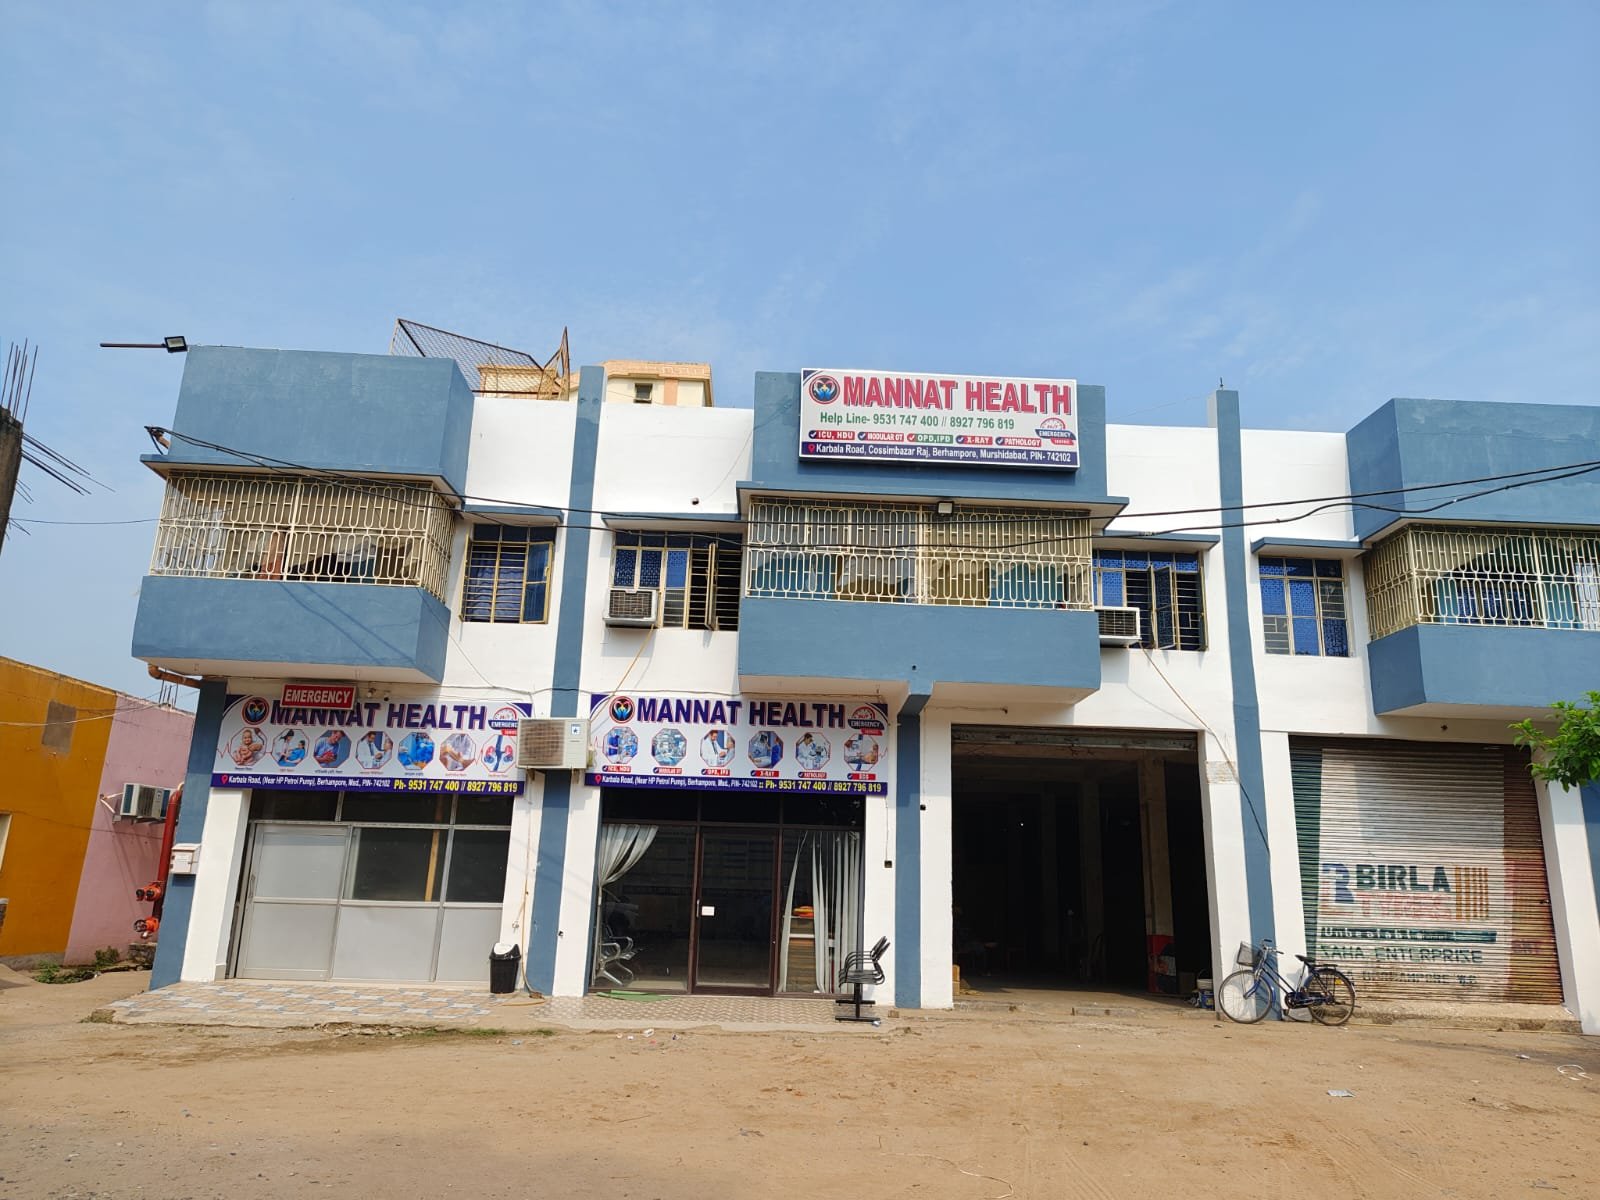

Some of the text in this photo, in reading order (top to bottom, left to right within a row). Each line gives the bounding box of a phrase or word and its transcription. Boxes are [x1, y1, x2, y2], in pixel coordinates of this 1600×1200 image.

[843, 376, 1071, 415] MANNAT HEALTH
[820, 411, 843, 426] Help
[846, 413, 870, 424] Line-
[873, 413, 896, 425] 9531
[900, 414, 917, 425] 747
[920, 416, 938, 427] 400
[950, 416, 974, 428] 8927
[976, 418, 994, 428] 796
[997, 418, 1014, 430] 819
[818, 431, 834, 439] ICU,
[1004, 438, 1040, 447] PATHOLOGY
[1039, 430, 1071, 438] EMERGENCY
[816, 443, 1071, 462] Karbala Road, Cossimbazar Raj, Berhampore, Murshidabad, PIN- 742102
[285, 689, 351, 704] EMERGENCY
[270, 700, 488, 730] MANNAT HEALTH
[637, 697, 845, 729] MANNAT HEALTH
[228, 775, 247, 783] Karbala
[247, 776, 262, 784] Road,
[262, 776, 276, 785] (Near
[276, 776, 283, 784] HP
[284, 776, 299, 785] Petrol
[317, 778, 347, 787] Berhampore,
[373, 779, 391, 787] 742102
[393, 779, 406, 790] Ph-
[408, 780, 427, 791] 9531
[429, 780, 444, 791] 747
[445, 781, 459, 791] 400
[467, 781, 486, 792] 8927
[488, 782, 502, 792] 796
[503, 782, 518, 793] 819
[602, 775, 620, 783] Karbala
[635, 776, 647, 785] (Near
[648, 776, 655, 784] HP
[655, 777, 670, 785] Petrol
[765, 779, 777, 788] Ph-
[778, 780, 796, 789] 9531
[798, 780, 811, 790] 747
[813, 781, 827, 791] 400
[833, 781, 852, 791] 8927
[853, 782, 866, 792] 796
[868, 783, 882, 792] 819
[1355, 864, 1451, 892] BIRLA
[1320, 945, 1482, 963] SAHA ENTERPRISE
